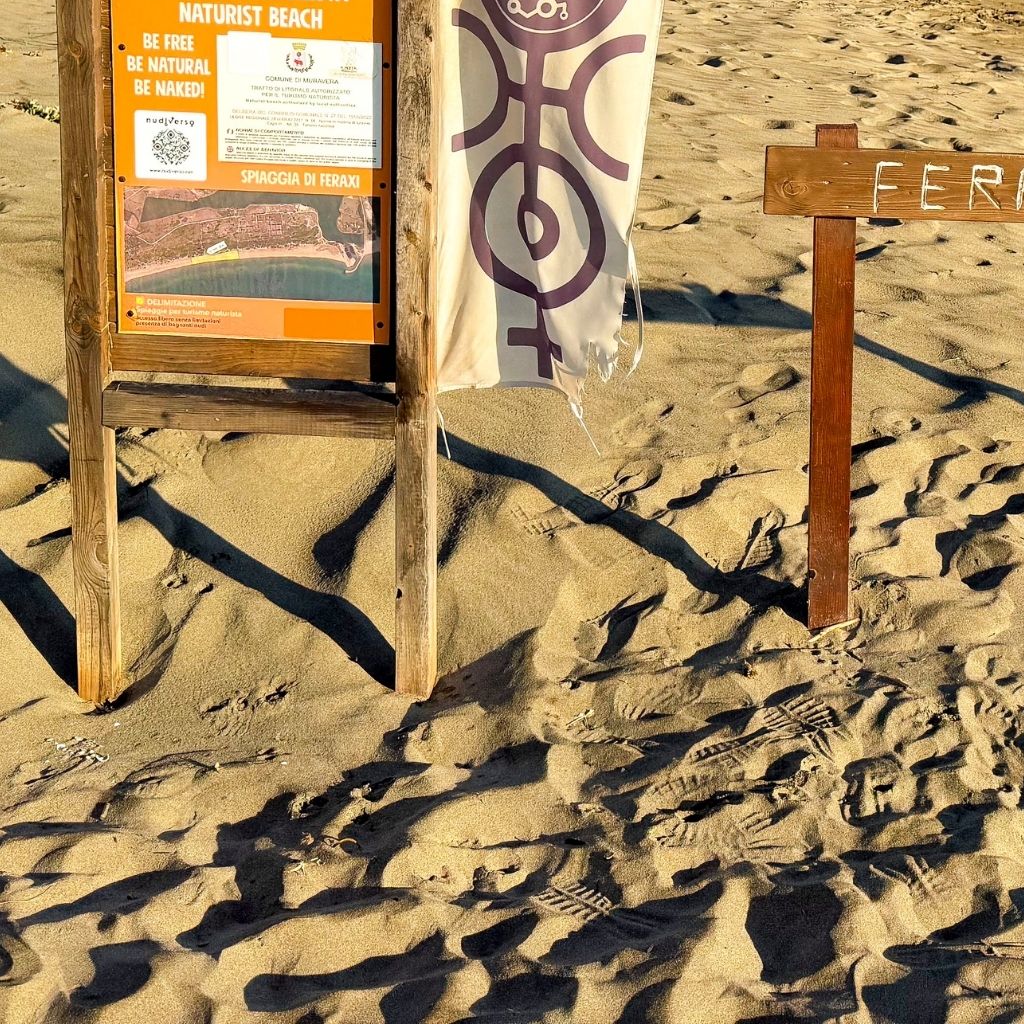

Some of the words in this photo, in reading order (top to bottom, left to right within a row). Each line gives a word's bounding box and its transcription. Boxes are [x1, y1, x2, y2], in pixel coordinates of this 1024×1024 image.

[179, 2, 262, 27] NATURIST
[269, 7, 323, 30] BEACH
[143, 32, 160, 50] BE
[164, 33, 194, 51] FREE
[127, 56, 144, 72] BE
[147, 57, 211, 75] NATURAL
[134, 79, 152, 95] BE
[155, 80, 204, 98] NAKED!
[146, 116, 195, 127] nudiverso
[240, 169, 301, 186] SPIAGGIA
[304, 173, 316, 186] DI
[319, 173, 361, 189] FERAXI
[146, 298, 207, 308] DELIMITAZIONE
